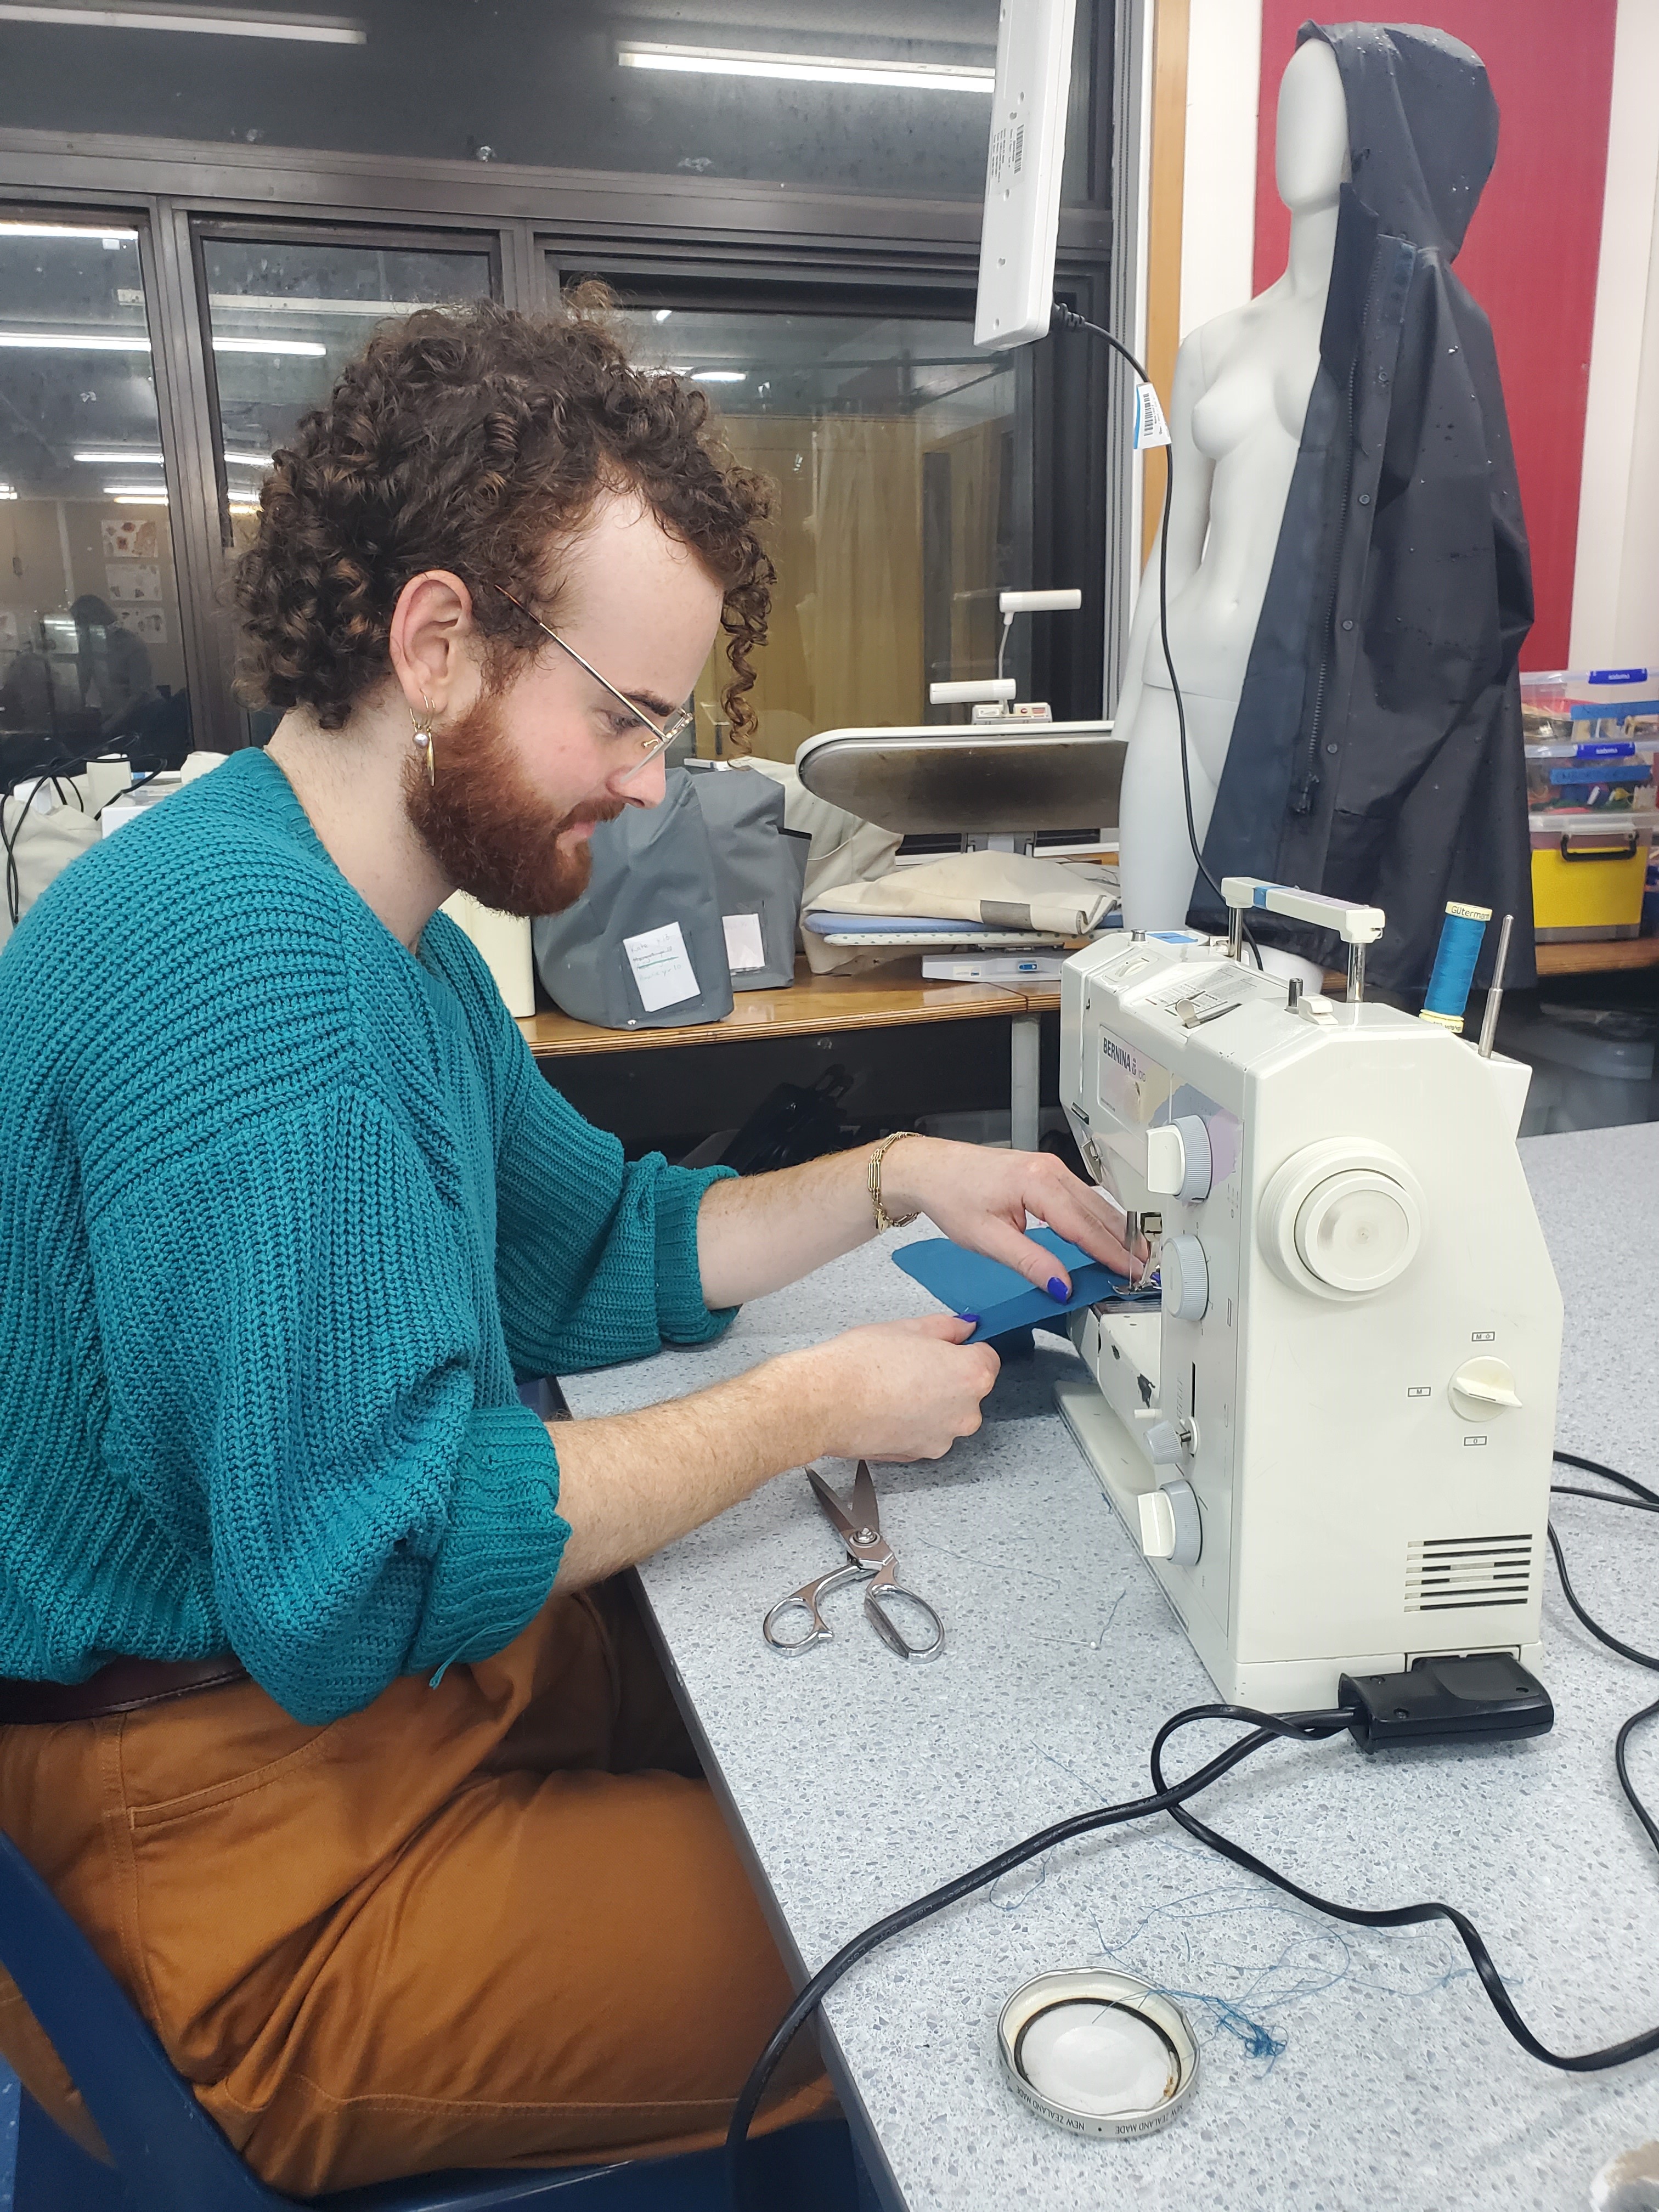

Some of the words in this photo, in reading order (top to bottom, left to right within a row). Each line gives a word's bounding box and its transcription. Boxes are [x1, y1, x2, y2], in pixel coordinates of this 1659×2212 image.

[1103, 1037, 1131, 1072] BERNINA
[1017, 2084, 1031, 2104] MADE
[1032, 2100, 1064, 2124] ZEALAND
[1066, 2118, 1085, 2131] NEW
[1115, 2123, 1137, 2134] MADE
[1138, 2113, 1169, 2131] ZEALAND
